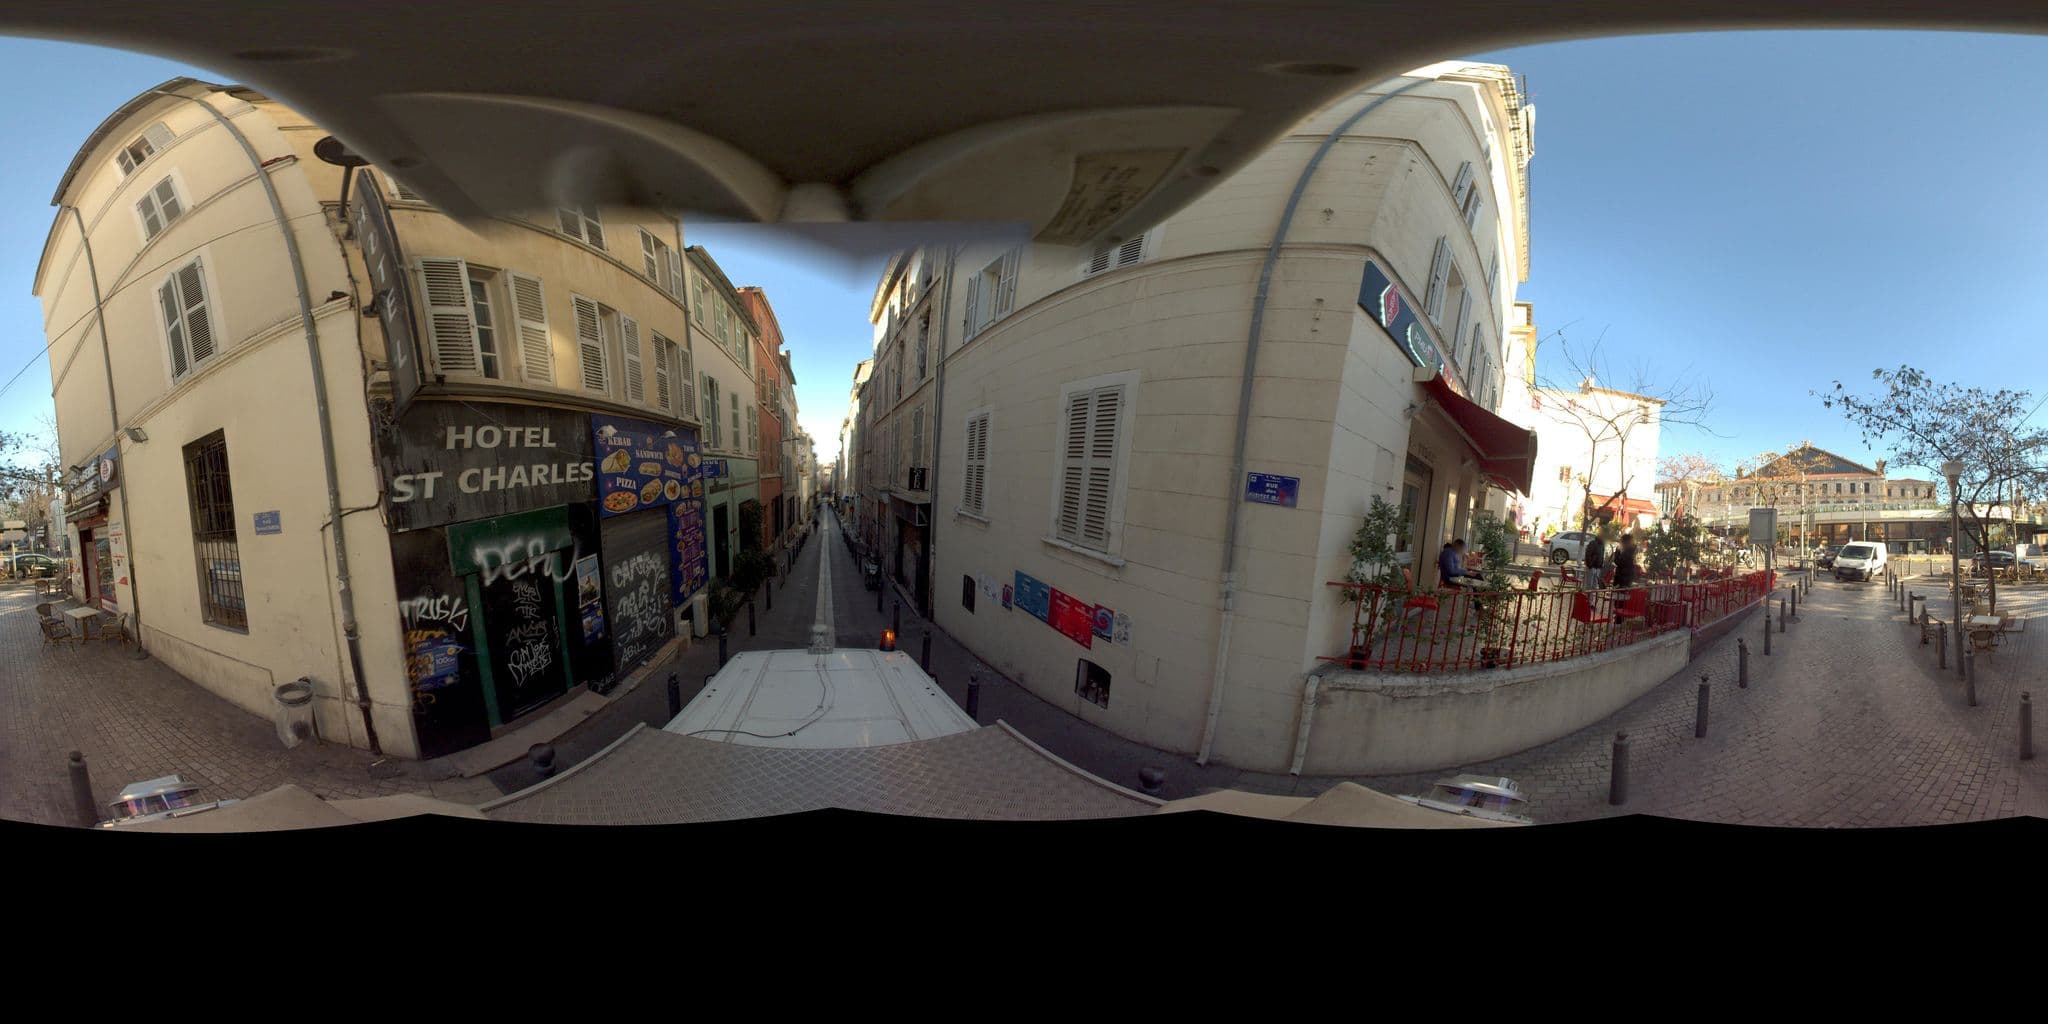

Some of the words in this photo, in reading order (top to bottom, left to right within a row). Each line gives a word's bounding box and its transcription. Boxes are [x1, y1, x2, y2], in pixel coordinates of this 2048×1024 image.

[446, 425, 556, 450] HOTEL
[608, 437, 632, 446] KEBAB
[636, 450, 663, 461] SANDWICH
[392, 471, 443, 503] ST
[458, 462, 594, 494] CHARLES
[616, 477, 637, 490] PIZZA
